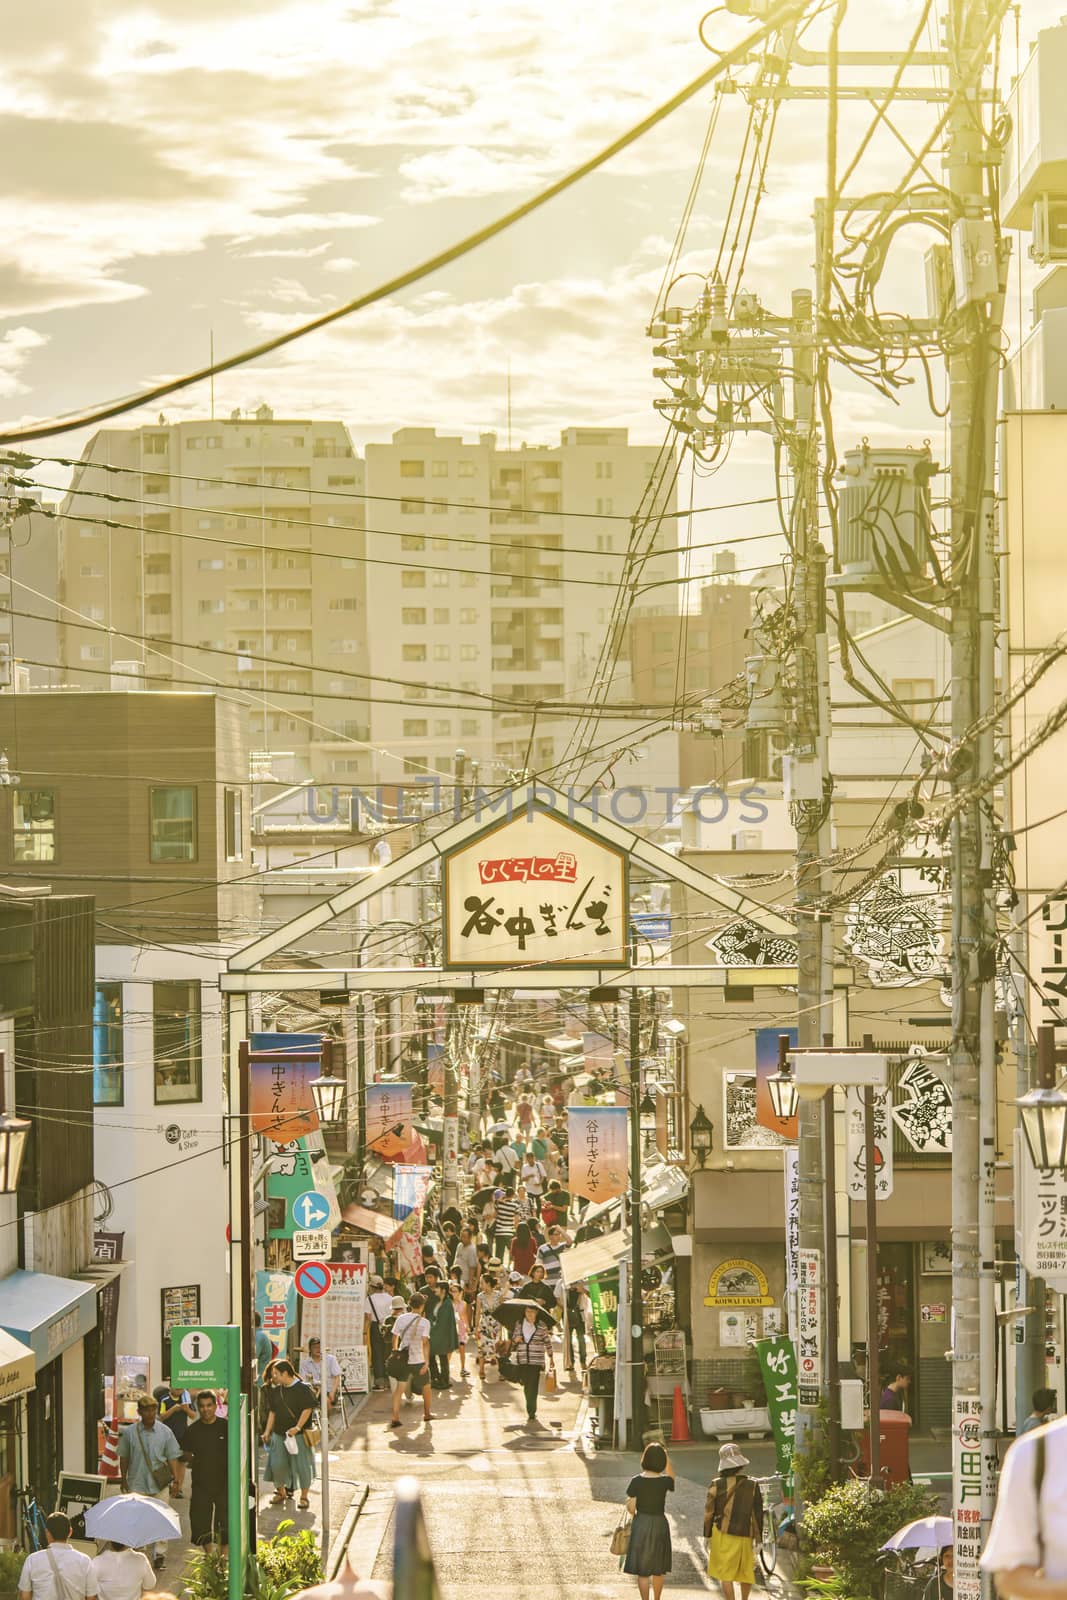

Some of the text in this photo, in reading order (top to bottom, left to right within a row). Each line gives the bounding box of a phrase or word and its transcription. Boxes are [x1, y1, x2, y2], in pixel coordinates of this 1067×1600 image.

[480, 852, 577, 882] ひぐらしの里
[461, 876, 612, 951] 谷中ぎんざ
[873, 1092, 888, 1140] かき氷
[586, 1119, 600, 1193] 谷中ぎんざ
[850, 1181, 889, 1193] ひ堂
[296, 1234, 328, 1242] 自転車を除く
[296, 1242, 328, 1250] 一方通行
[766, 1348, 797, 1438] 竹工芸
[964, 1424, 979, 1442] 質
[960, 1452, 981, 1504] 田戸
